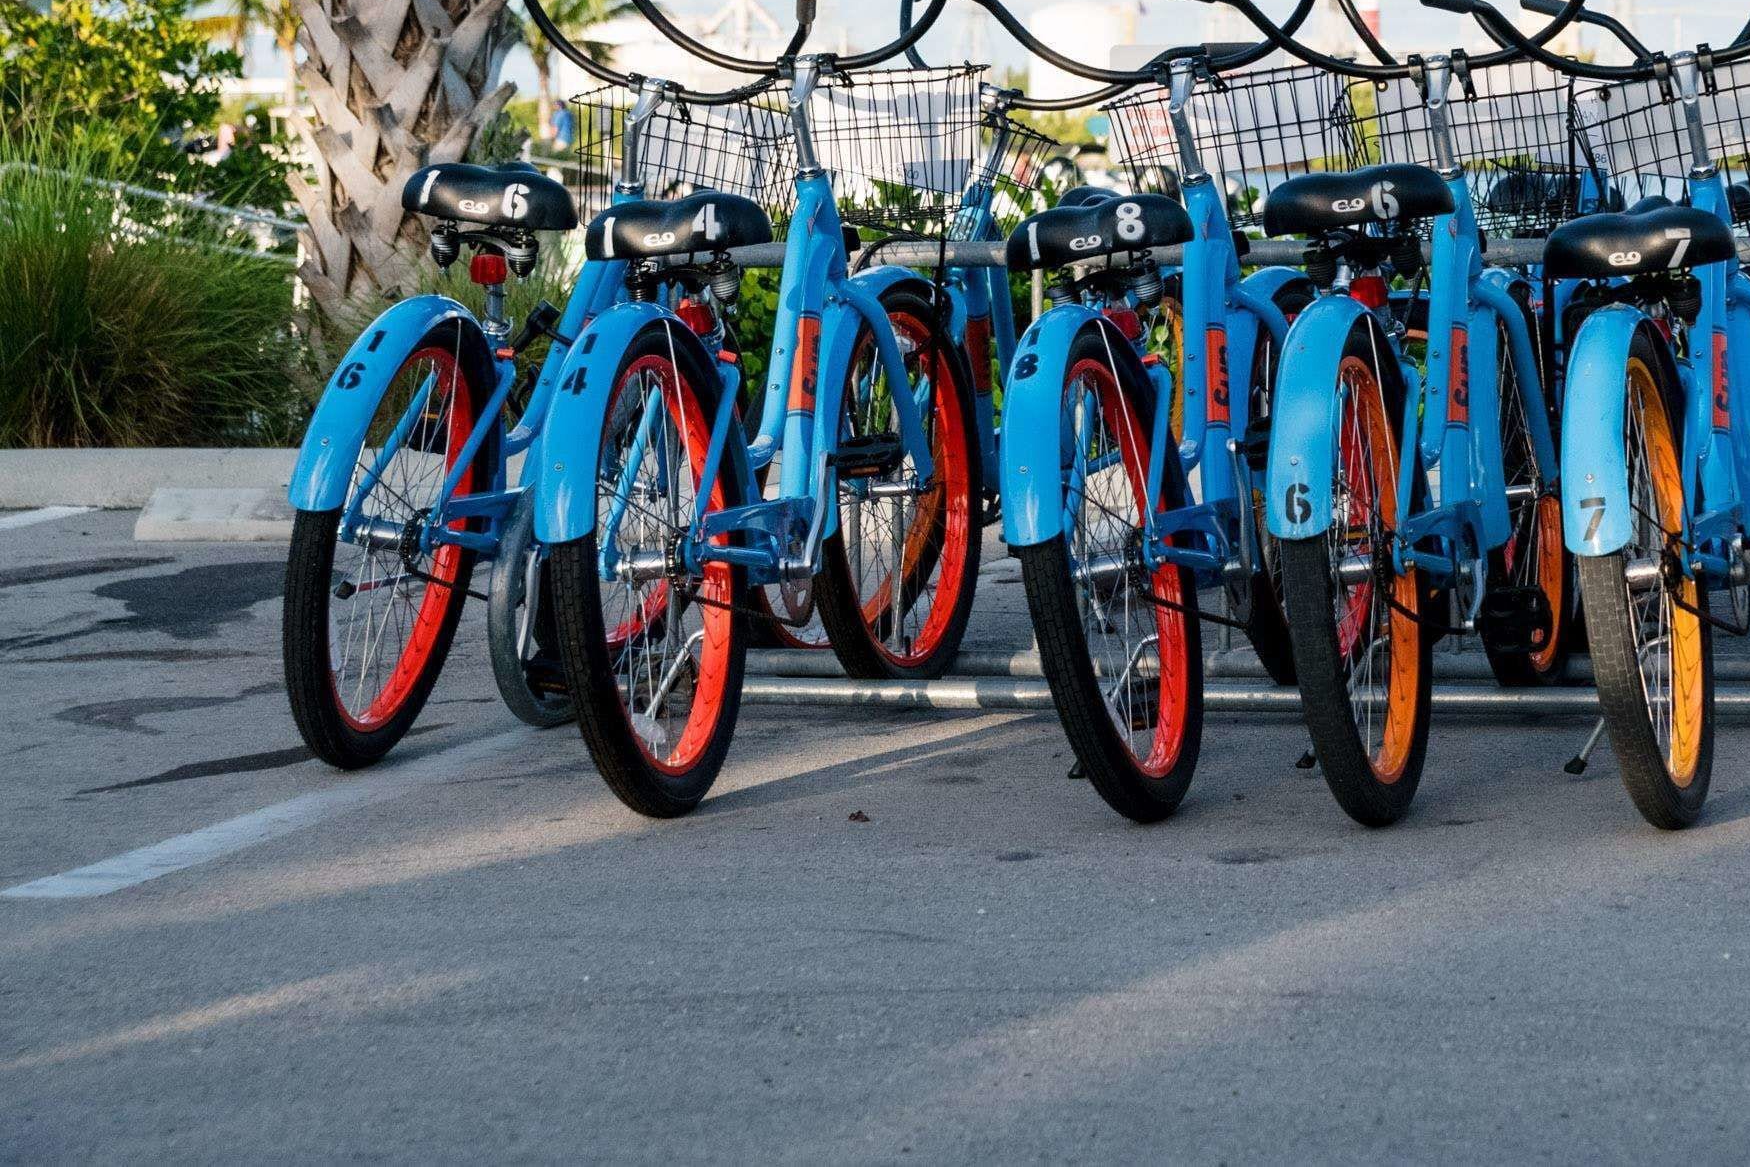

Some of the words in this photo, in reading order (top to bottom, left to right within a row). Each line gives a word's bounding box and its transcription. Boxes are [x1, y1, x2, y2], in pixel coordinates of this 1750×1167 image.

[1371, 180, 1400, 219] 6
[1664, 228, 1691, 268] 7
[1285, 483, 1312, 524] 6
[1580, 497, 1606, 542] 7
